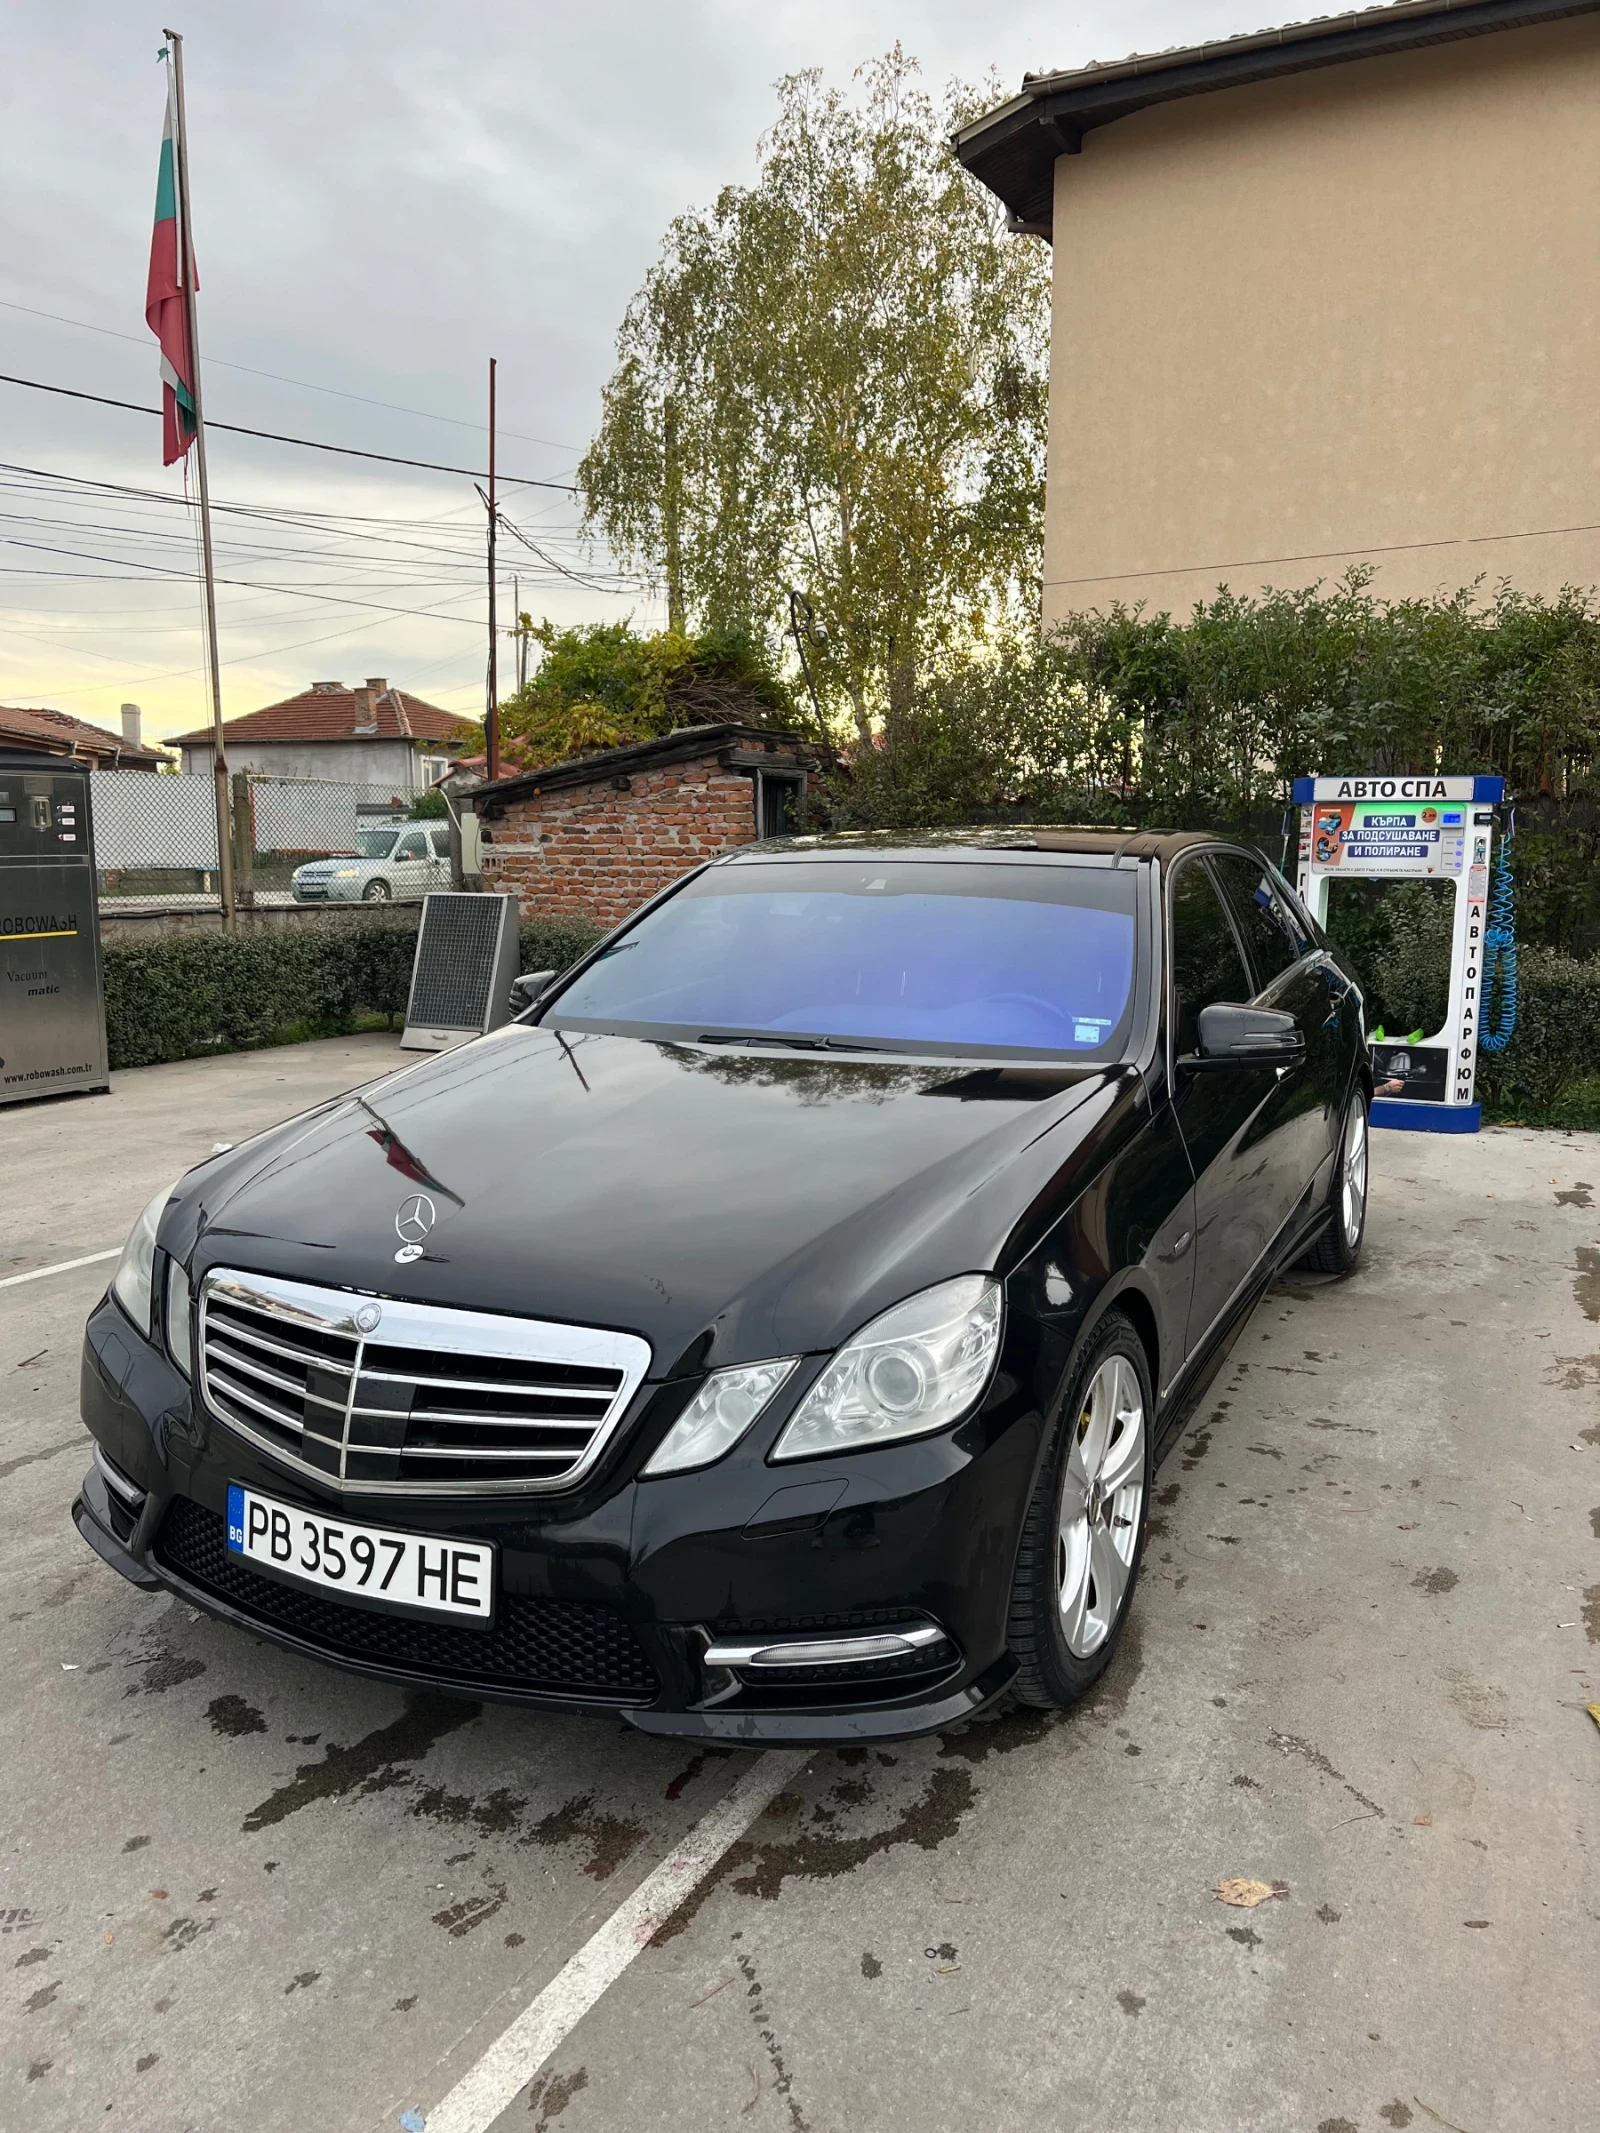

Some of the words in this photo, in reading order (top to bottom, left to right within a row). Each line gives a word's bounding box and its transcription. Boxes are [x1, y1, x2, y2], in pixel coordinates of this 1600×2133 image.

[1337, 780, 1396, 798] АВТО
[1401, 780, 1447, 798] СПА
[1371, 816, 1408, 827] КЪРПА
[1422, 811, 1427, 819] 2
[1341, 831, 1355, 841] ЗА
[1357, 831, 1437, 842] ПОДСУШАВАНЕ
[1354, 846, 1362, 856] И
[1364, 846, 1421, 857] ПОЛИРАНЕ
[7, 970, 48, 983] Vacuum
[28, 984, 60, 996] matic
[1456, 905, 1481, 1101] АВТОПАРФЮМ
[4, 1063, 92, 1084] www.robowash.com.tr
[229, 1525, 243, 1544] BG
[248, 1499, 292, 1562] PB
[300, 1521, 406, 1591] 3597
[417, 1544, 481, 1608] HE
